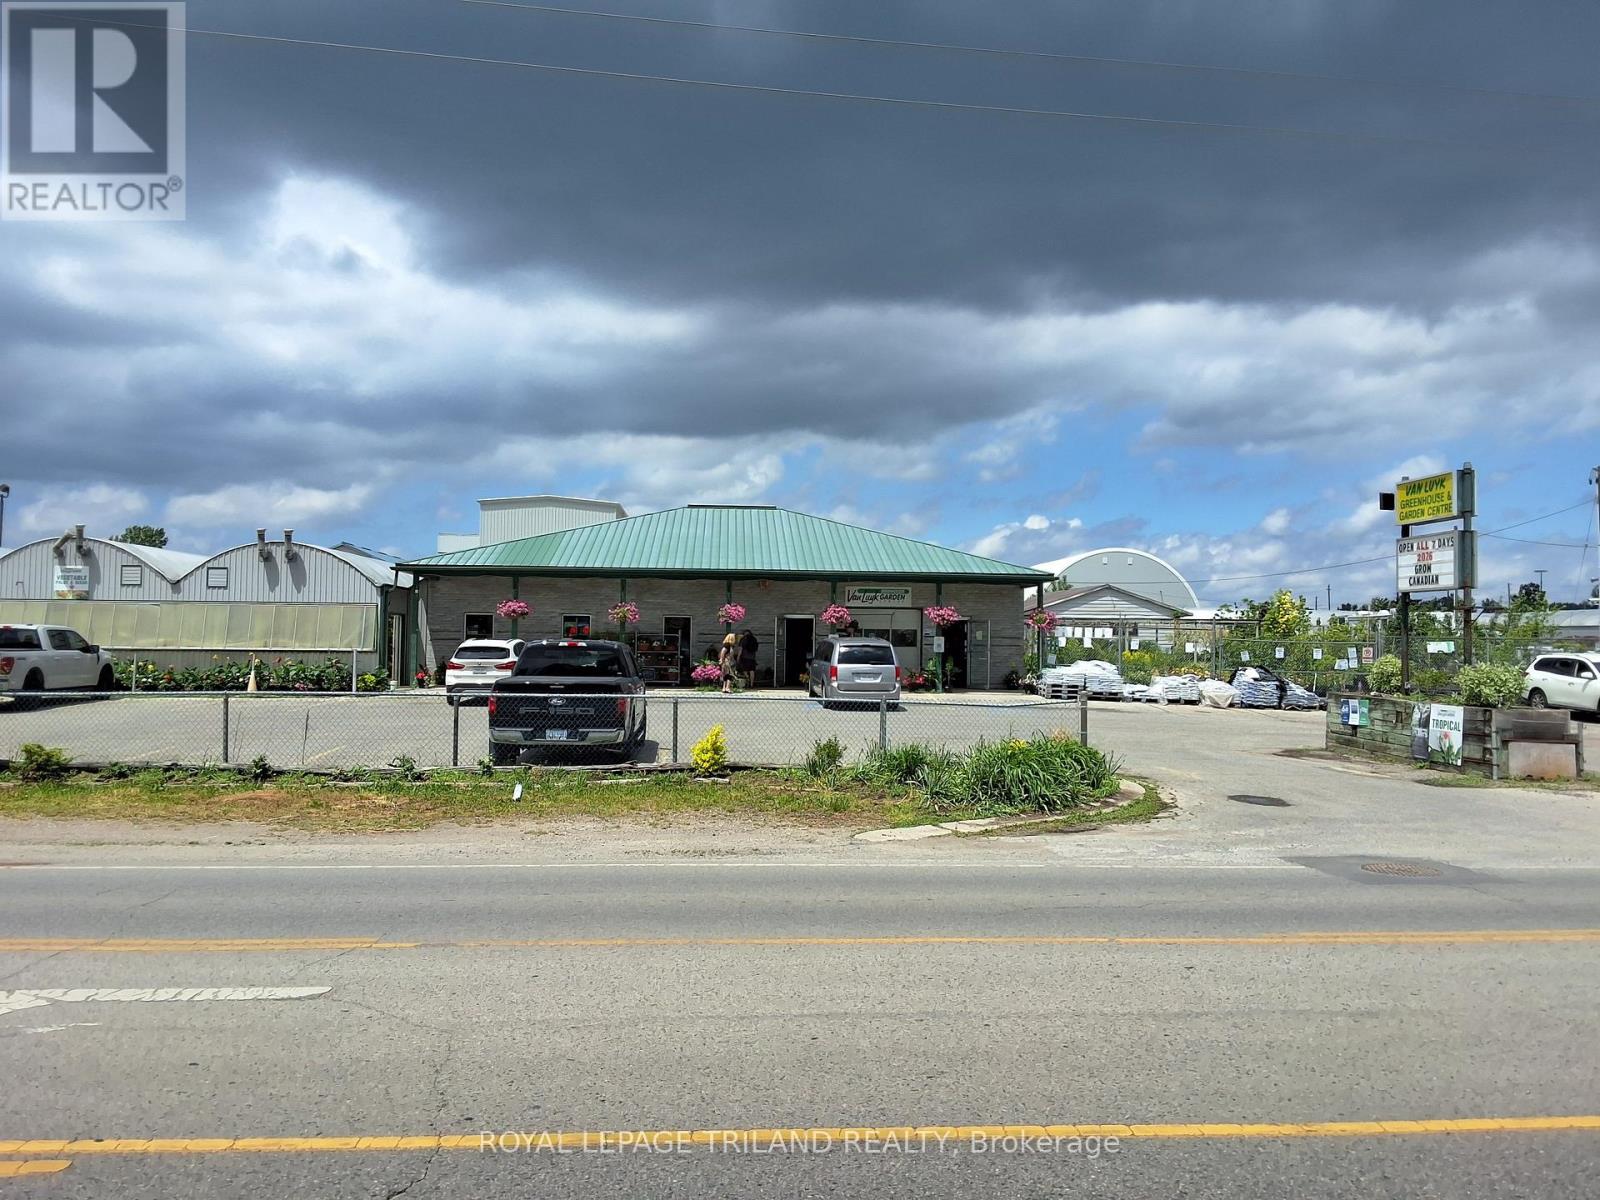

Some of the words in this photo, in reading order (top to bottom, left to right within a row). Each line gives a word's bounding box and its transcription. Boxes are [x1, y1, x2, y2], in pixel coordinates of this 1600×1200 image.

[1405, 483, 1424, 496] VAN
[1424, 478, 1446, 493] LUYK
[1400, 494, 1448, 509] GREENHOUSE
[1399, 508, 1425, 521] GARDEN
[1427, 502, 1453, 517] CENTRE
[1399, 543, 1414, 553] OPEN
[1416, 541, 1429, 551] ALL
[1437, 537, 1454, 549] DAYS
[1408, 575, 1439, 586] CANADIAN
[847, 590, 861, 602] Van
[861, 590, 880, 604] Luyk
[880, 593, 906, 601] GARDEN
[1432, 718, 1461, 732] TROPICAL
